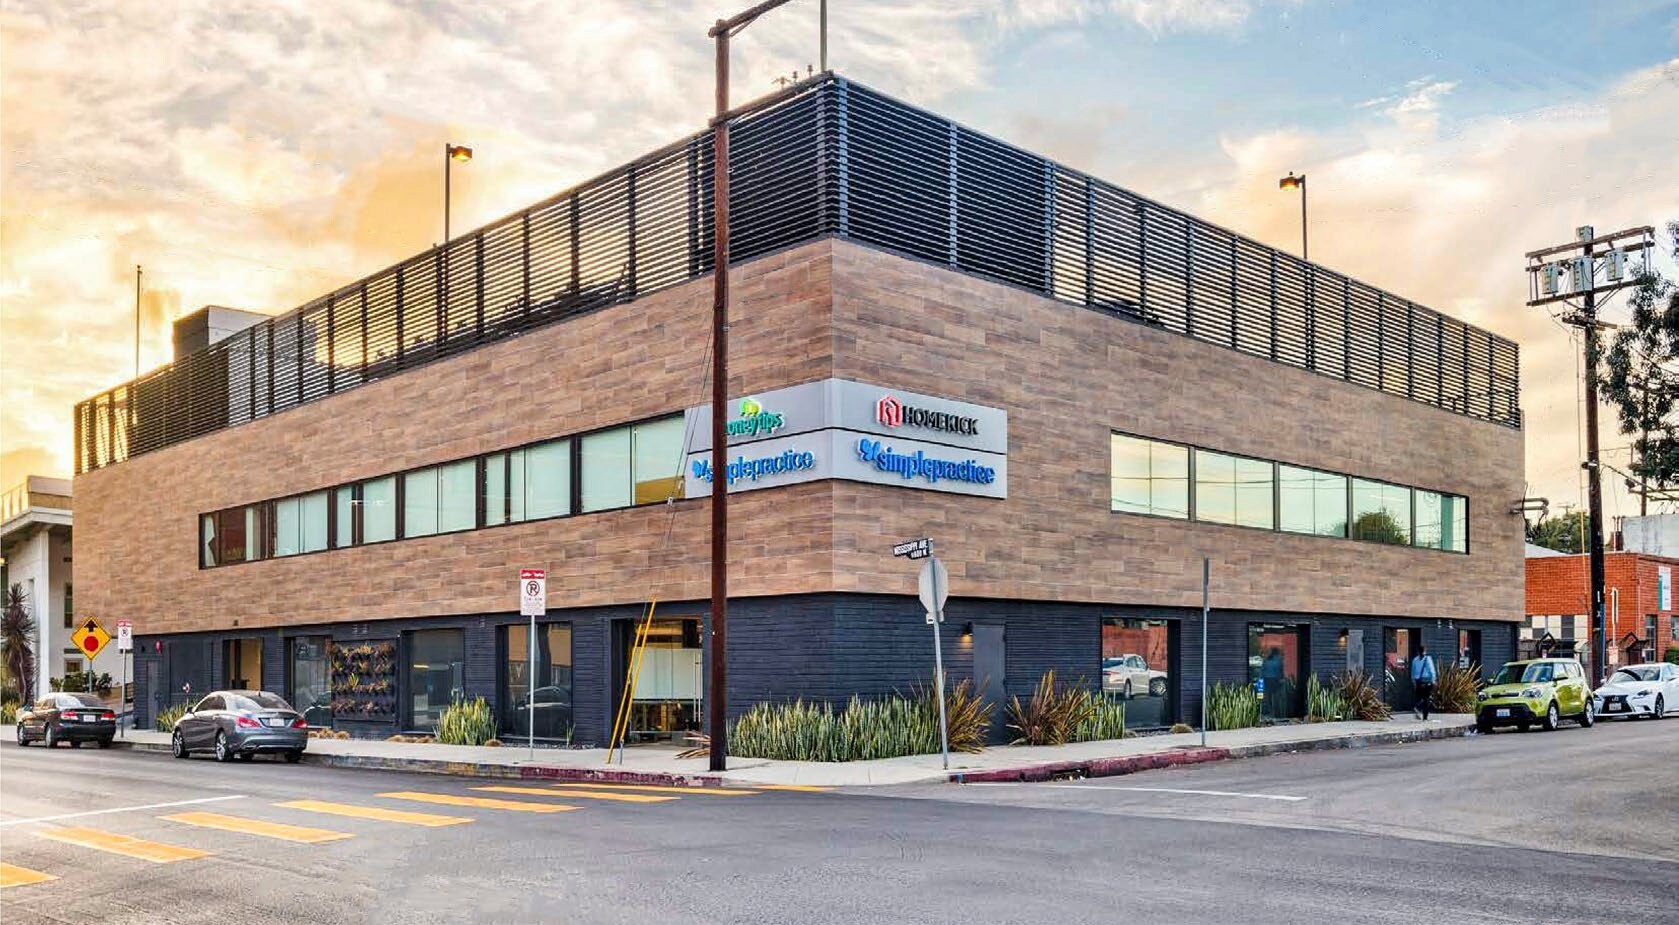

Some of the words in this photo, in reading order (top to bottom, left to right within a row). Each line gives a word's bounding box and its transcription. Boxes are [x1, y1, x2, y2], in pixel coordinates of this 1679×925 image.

[726, 412, 784, 436] oneytips
[902, 405, 979, 435] HOMEKICK
[706, 449, 814, 484] splepractice
[877, 447, 996, 484] simplepractice
